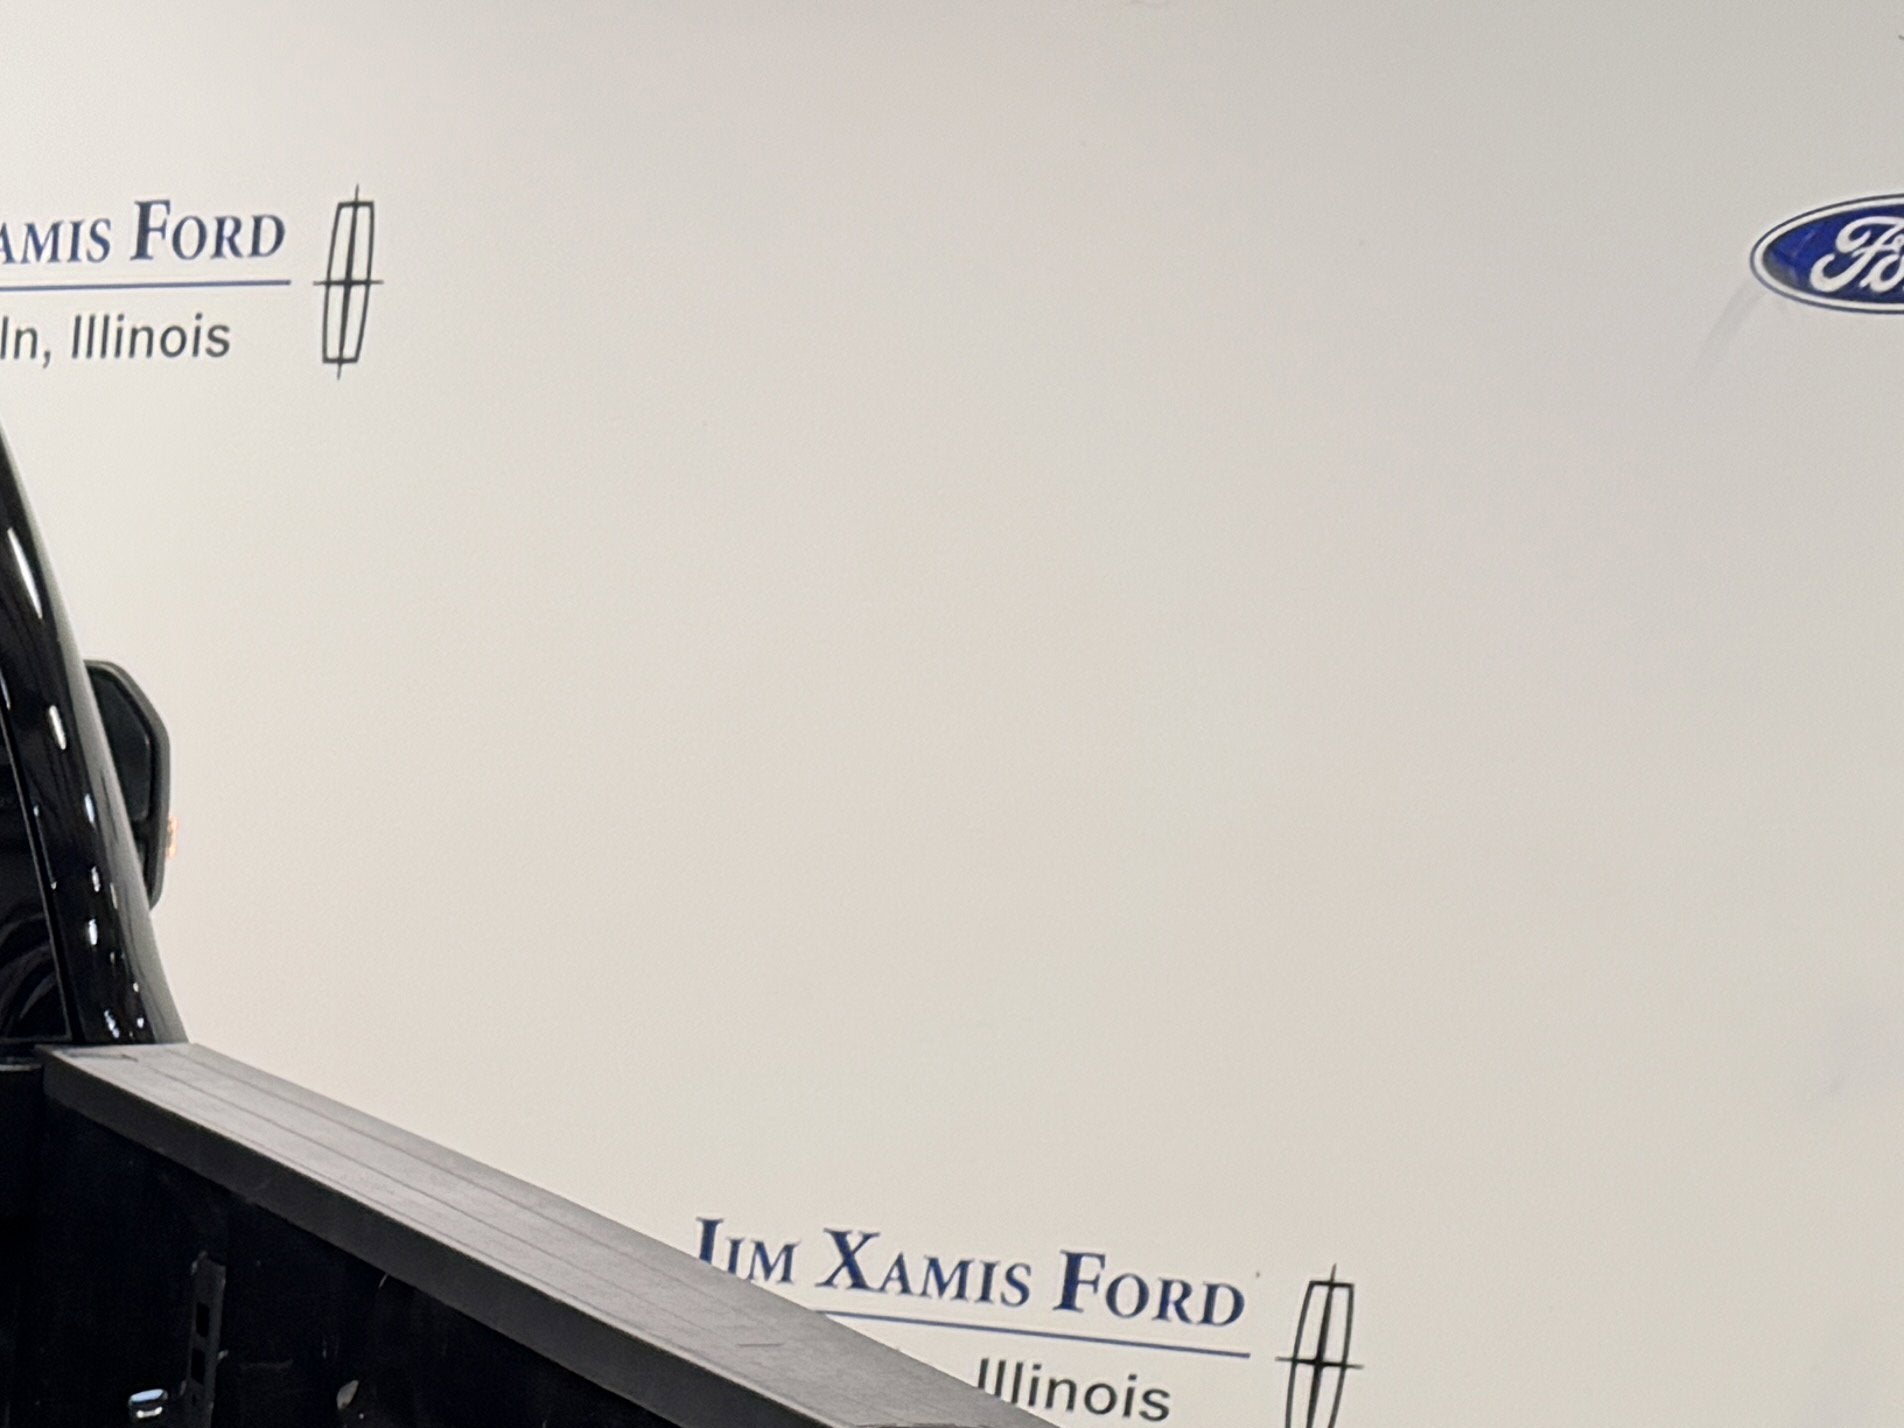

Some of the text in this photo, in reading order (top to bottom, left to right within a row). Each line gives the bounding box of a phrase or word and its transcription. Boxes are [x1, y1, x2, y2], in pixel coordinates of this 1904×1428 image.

[130, 198, 286, 261] FORD
[71, 312, 231, 359] Illinois
[814, 1227, 1033, 1308] XAMIS
[1053, 1249, 1246, 1327] FORD
[977, 1357, 1171, 1423] Illinois
